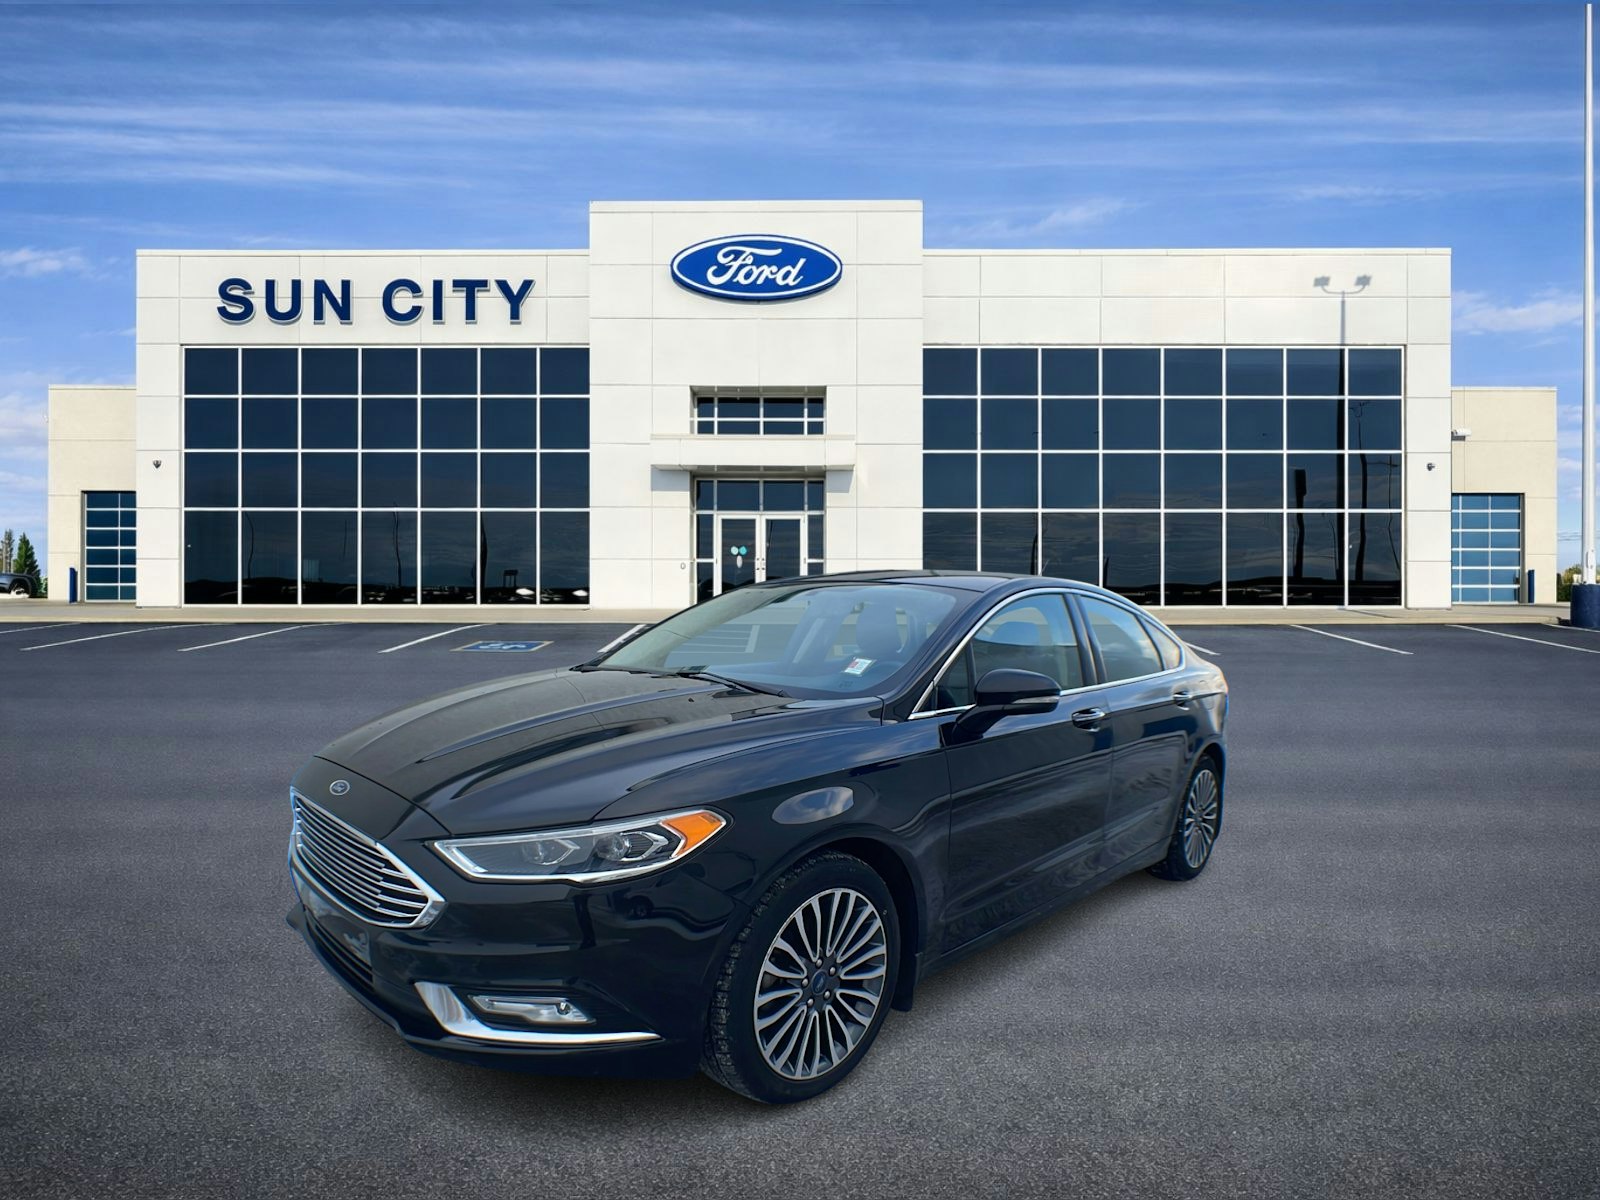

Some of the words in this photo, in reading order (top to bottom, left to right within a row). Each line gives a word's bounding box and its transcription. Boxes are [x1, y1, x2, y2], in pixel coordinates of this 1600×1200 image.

[706, 246, 806, 286] Ford
[217, 278, 353, 325] SUN
[382, 278, 535, 325] CITY
